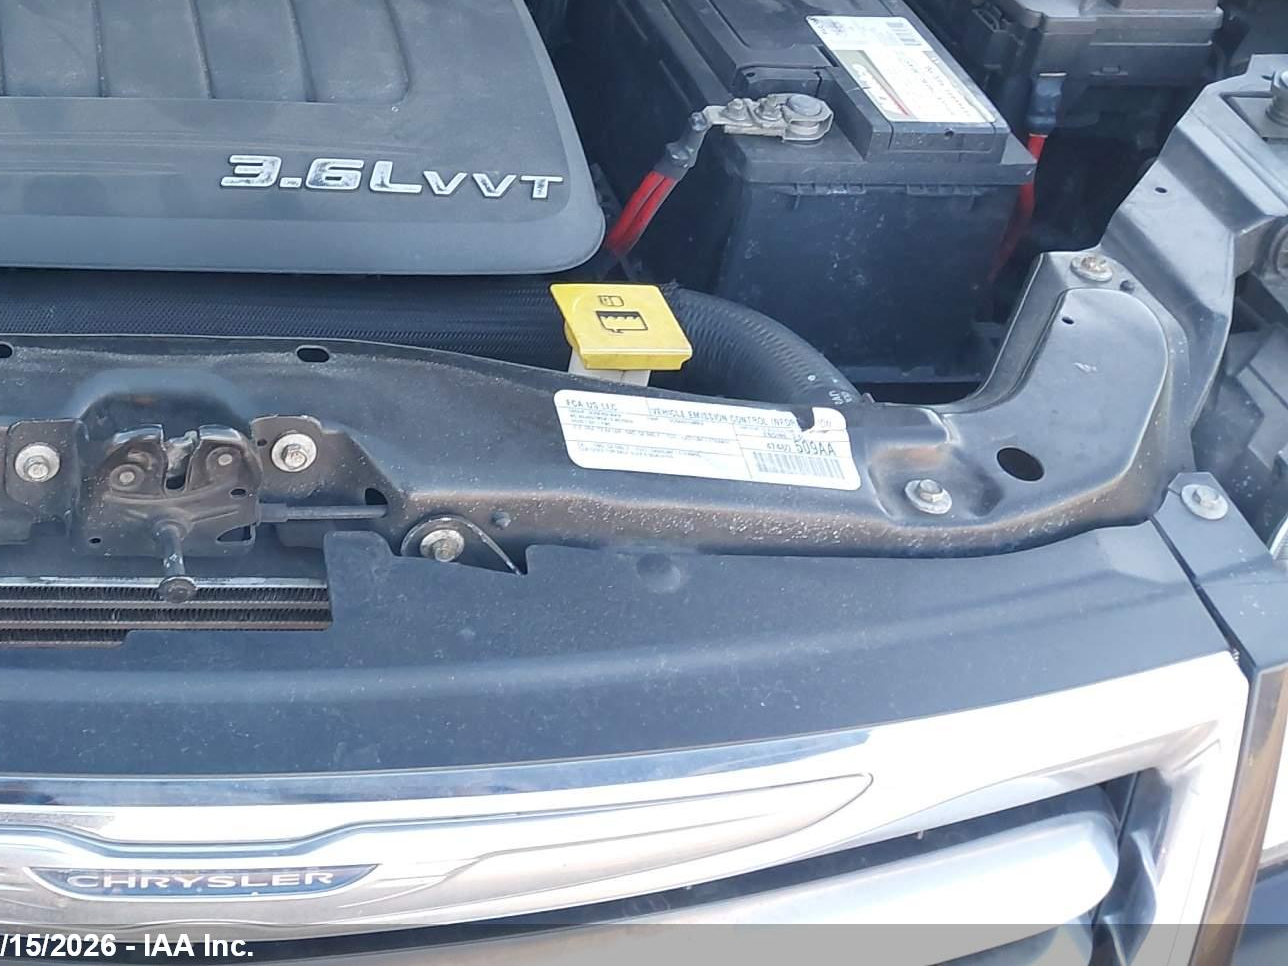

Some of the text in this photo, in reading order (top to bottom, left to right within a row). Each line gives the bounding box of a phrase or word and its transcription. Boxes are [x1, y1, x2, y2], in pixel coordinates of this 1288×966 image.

[565, 399, 583, 408] FCA
[585, 401, 599, 410] US
[652, 408, 685, 418] VEHICLE
[687, 411, 728, 422] EMISSION
[731, 414, 768, 425] CONTROL
[65, 871, 334, 890] CHRYSLER
